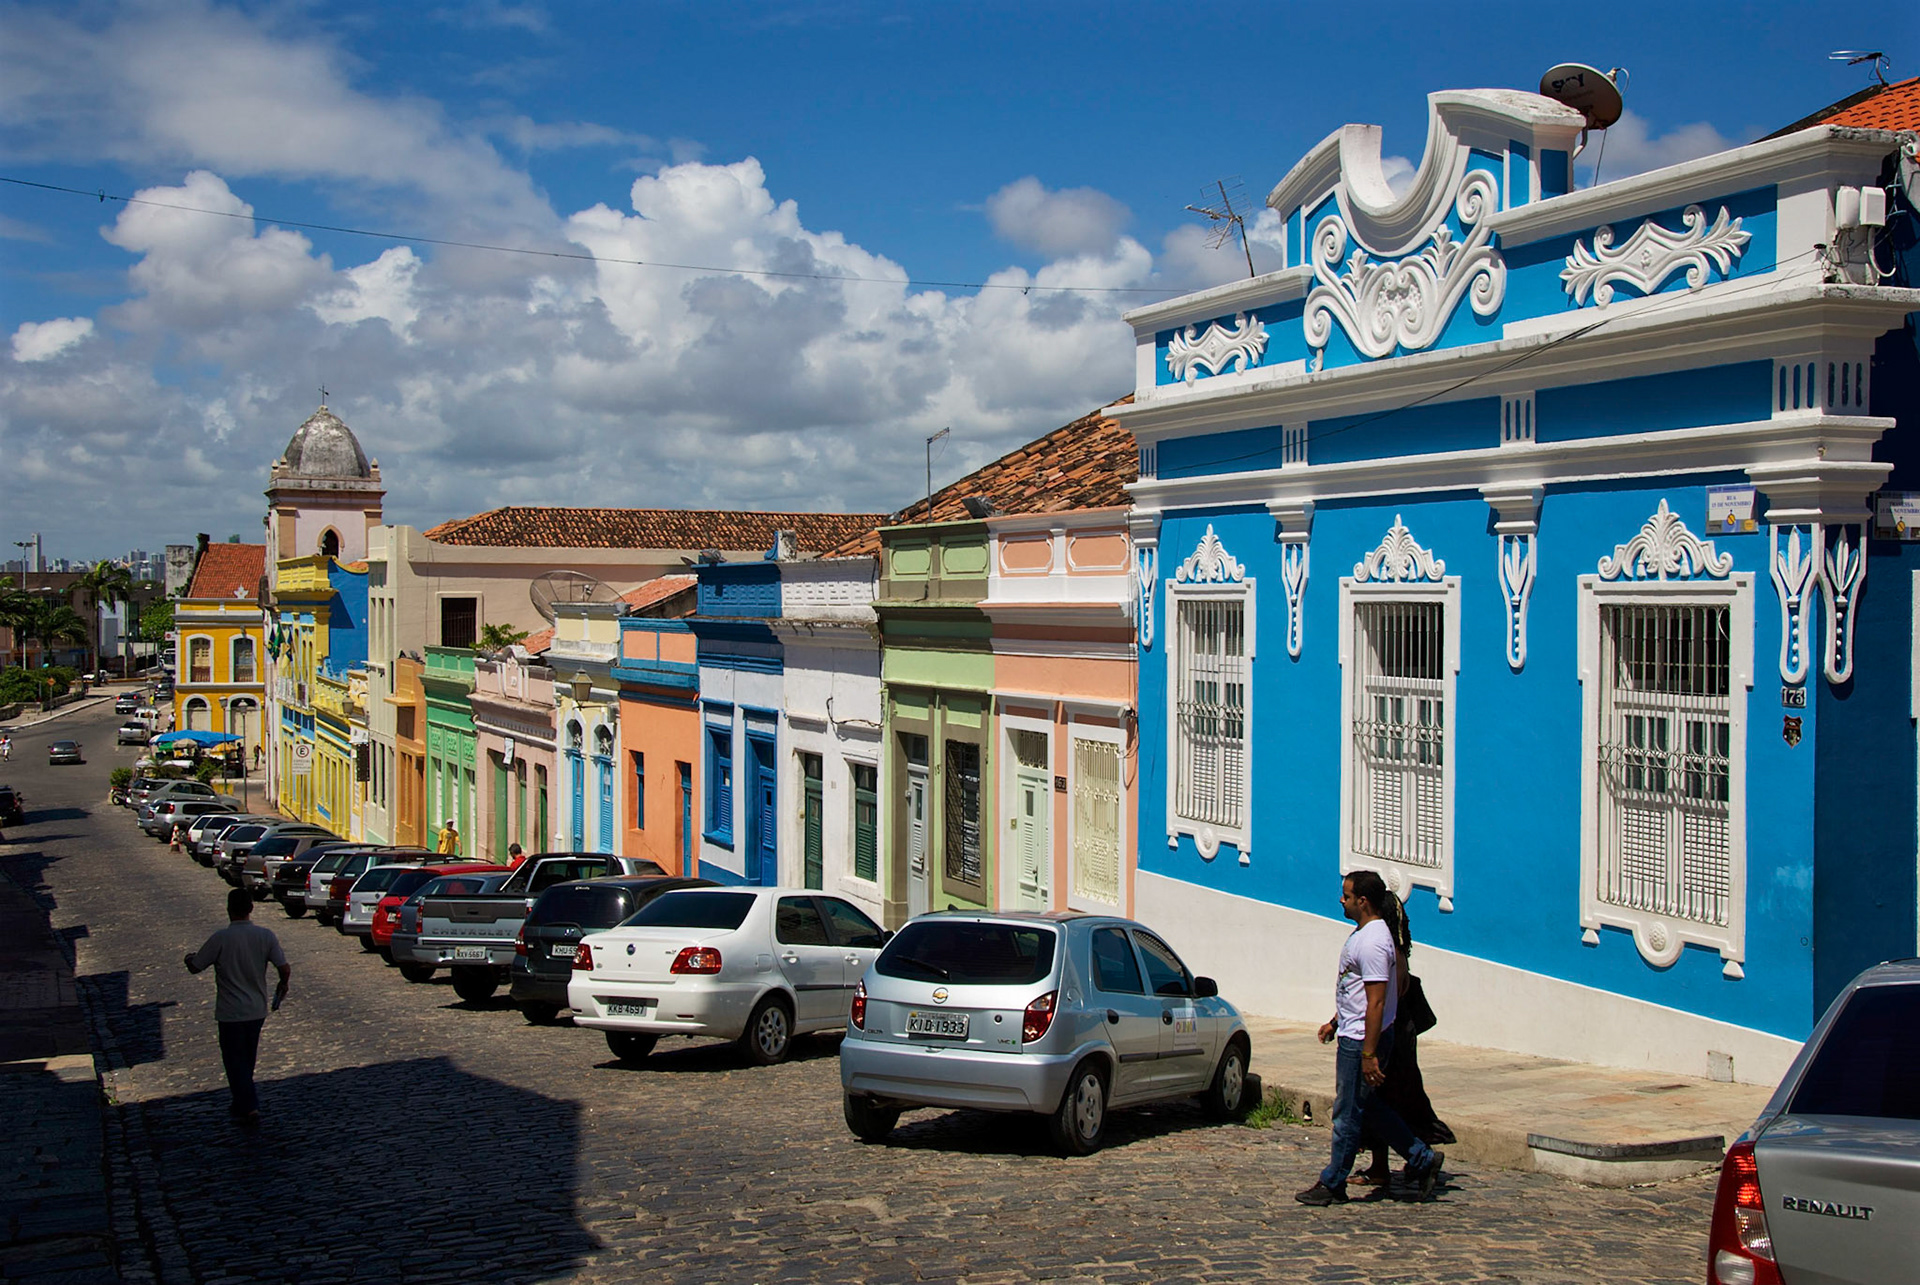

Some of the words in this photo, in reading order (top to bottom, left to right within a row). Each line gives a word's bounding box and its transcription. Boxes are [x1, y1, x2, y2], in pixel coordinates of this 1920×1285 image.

[1552, 72, 1584, 93] SY
[1783, 689, 1804, 705] 173
[431, 928, 512, 936] CHEVROLET
[1782, 1195, 1875, 1221] RENAULT
